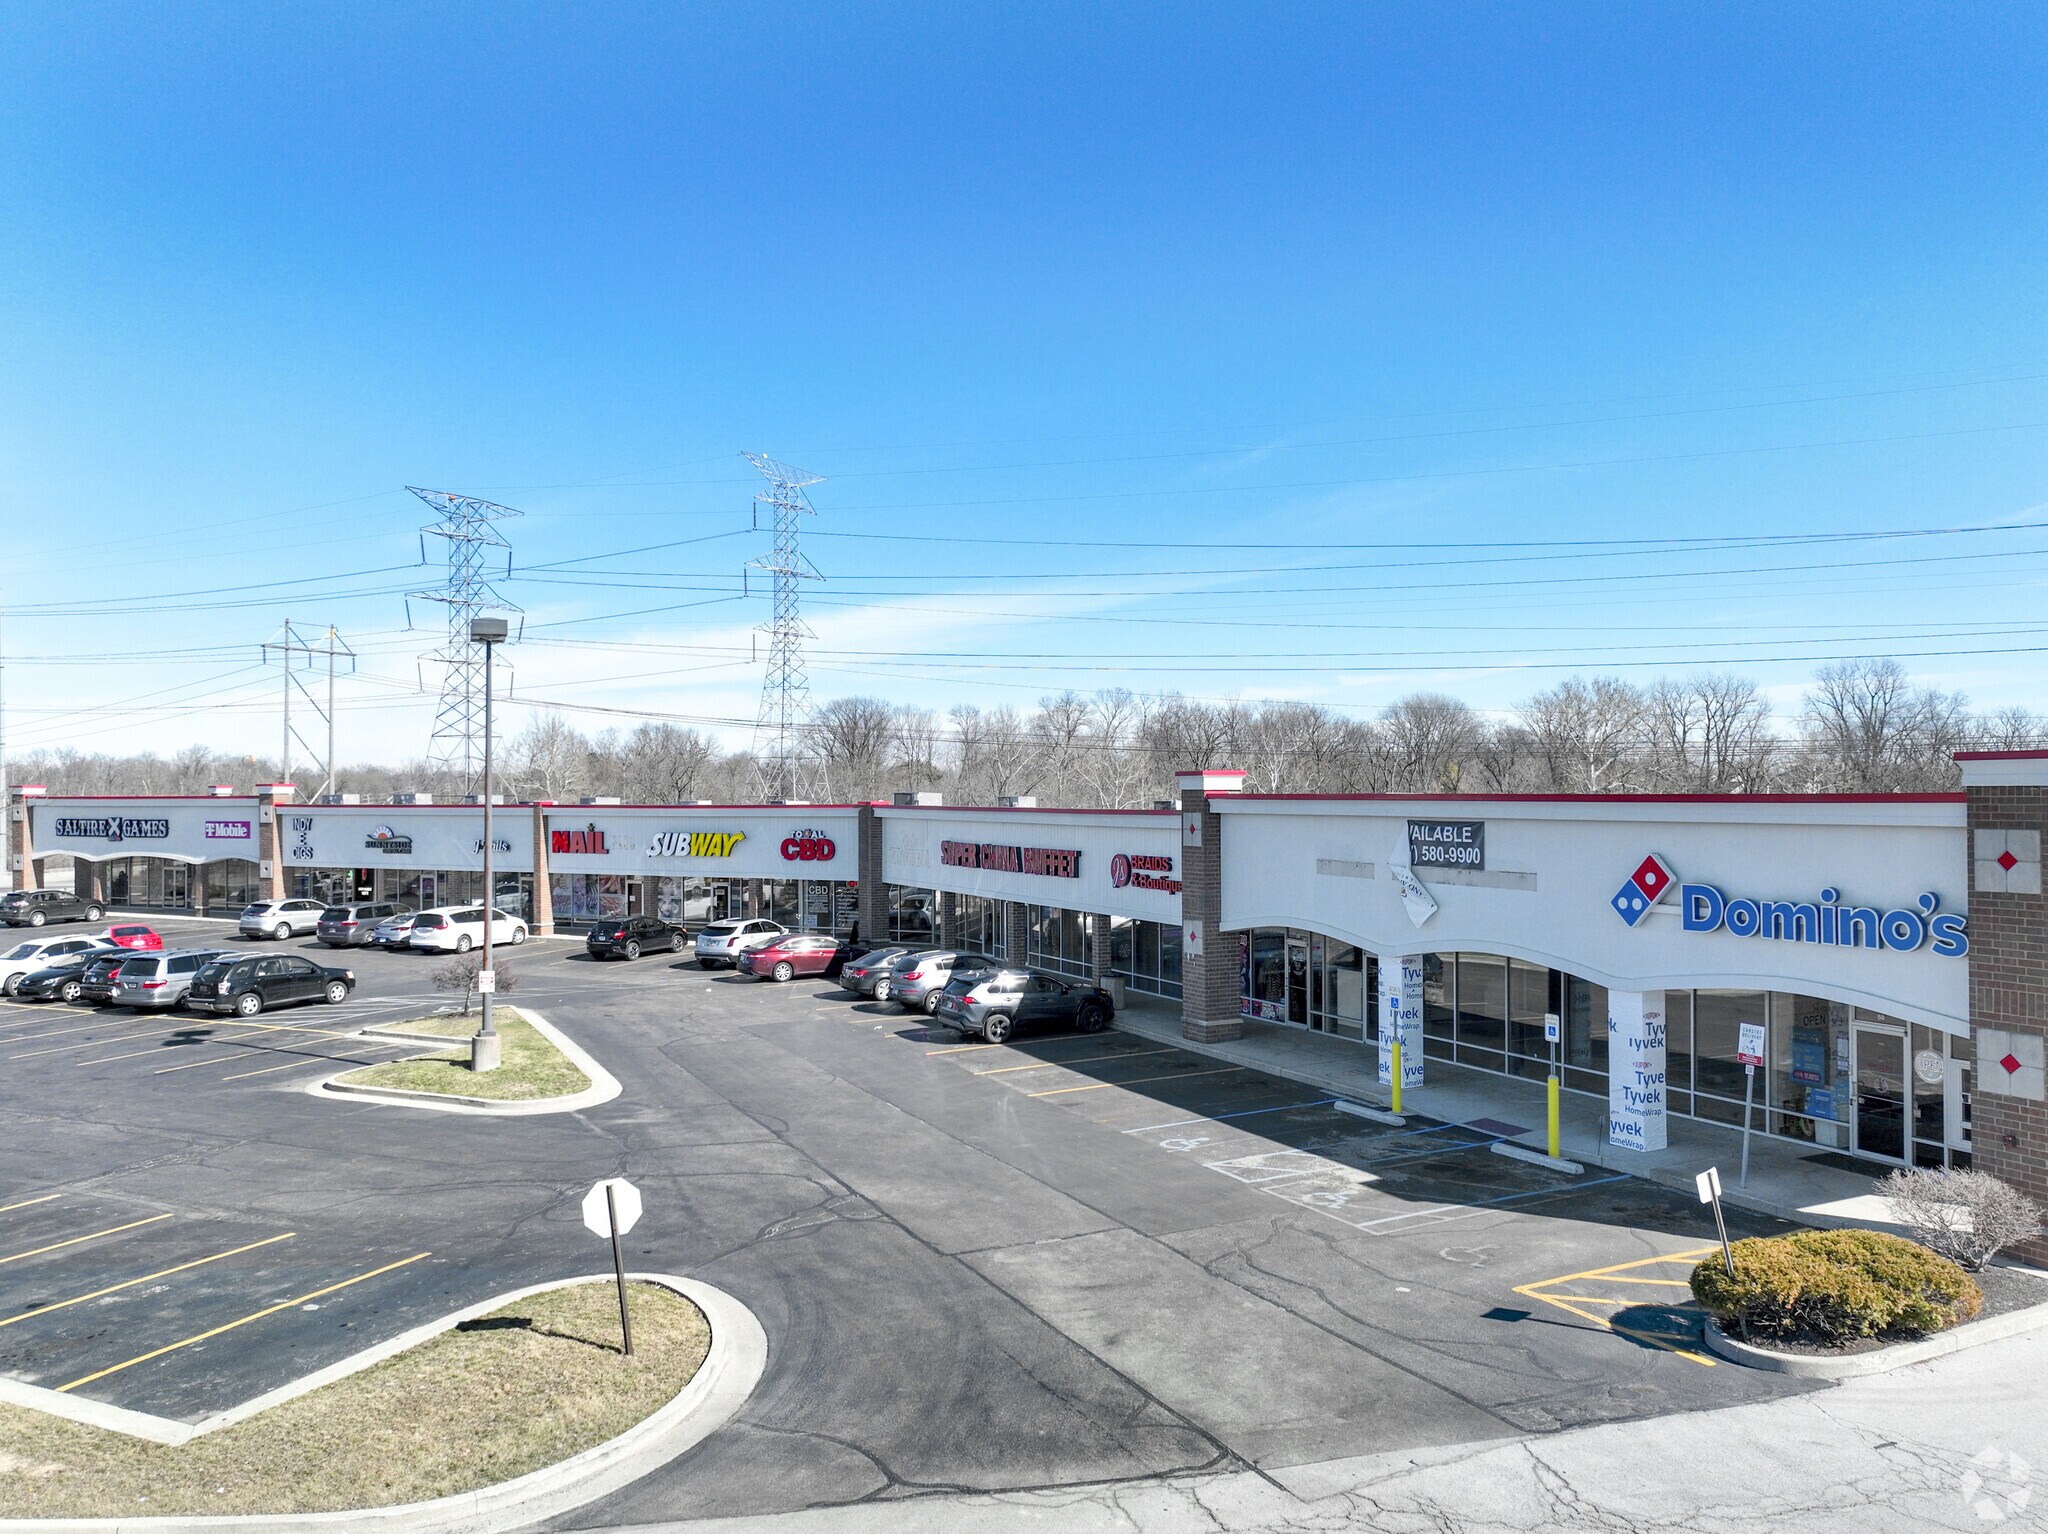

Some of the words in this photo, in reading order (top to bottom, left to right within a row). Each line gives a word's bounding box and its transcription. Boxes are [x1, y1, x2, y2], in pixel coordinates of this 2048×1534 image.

[56, 819, 107, 836] SALTIRE
[123, 820, 168, 838] GAMES
[292, 818, 313, 831] INDY
[552, 829, 609, 854] NAIL
[645, 831, 746, 857] SUBWAY
[781, 838, 836, 861] CBD
[292, 847, 314, 859] CIGS
[941, 840, 981, 868] SUPER
[981, 844, 1023, 873] CHINA
[1023, 847, 1082, 878] BUFFET
[1422, 846, 1481, 864] 580-9900
[1131, 855, 1173, 872] BRAIDS
[808, 885, 829, 895] CBD
[1681, 884, 1970, 958] Domino's
[1917, 1057, 1943, 1074] OPEN
[1622, 1085, 1661, 1106] Tyvek
